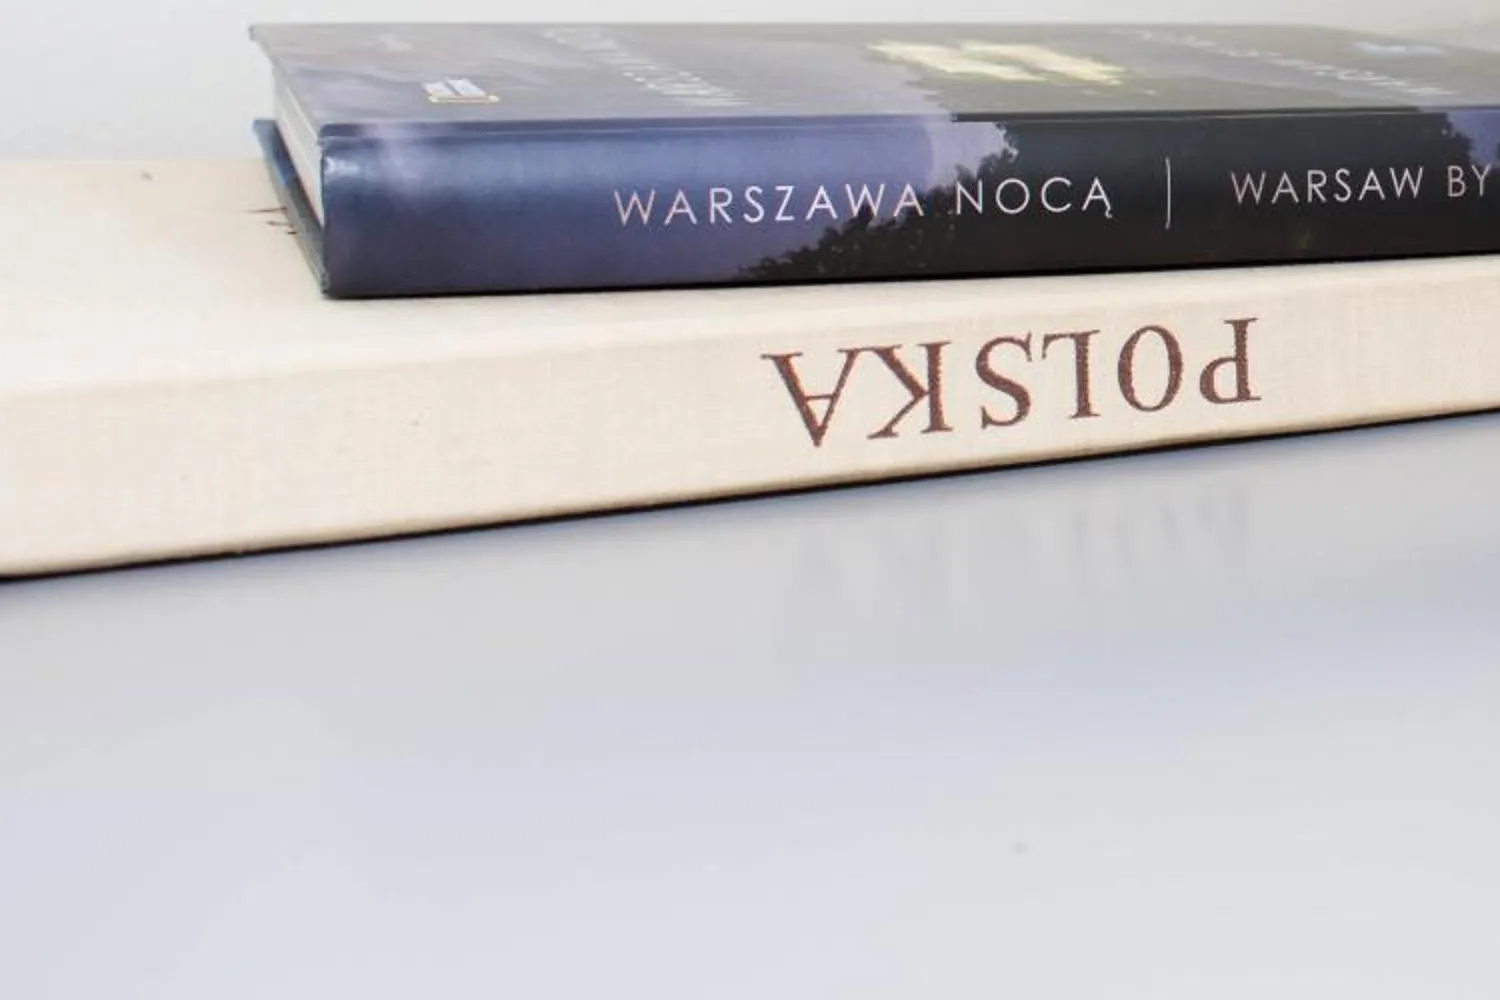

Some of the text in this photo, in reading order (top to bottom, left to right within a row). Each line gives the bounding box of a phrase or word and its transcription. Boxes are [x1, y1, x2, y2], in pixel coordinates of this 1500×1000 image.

[612, 176, 1112, 226] WARSZAWA NOCĄ
[1230, 165, 1424, 204] WARSAW
[1446, 163, 1492, 198] BY
[760, 316, 1263, 448] POLSKA
